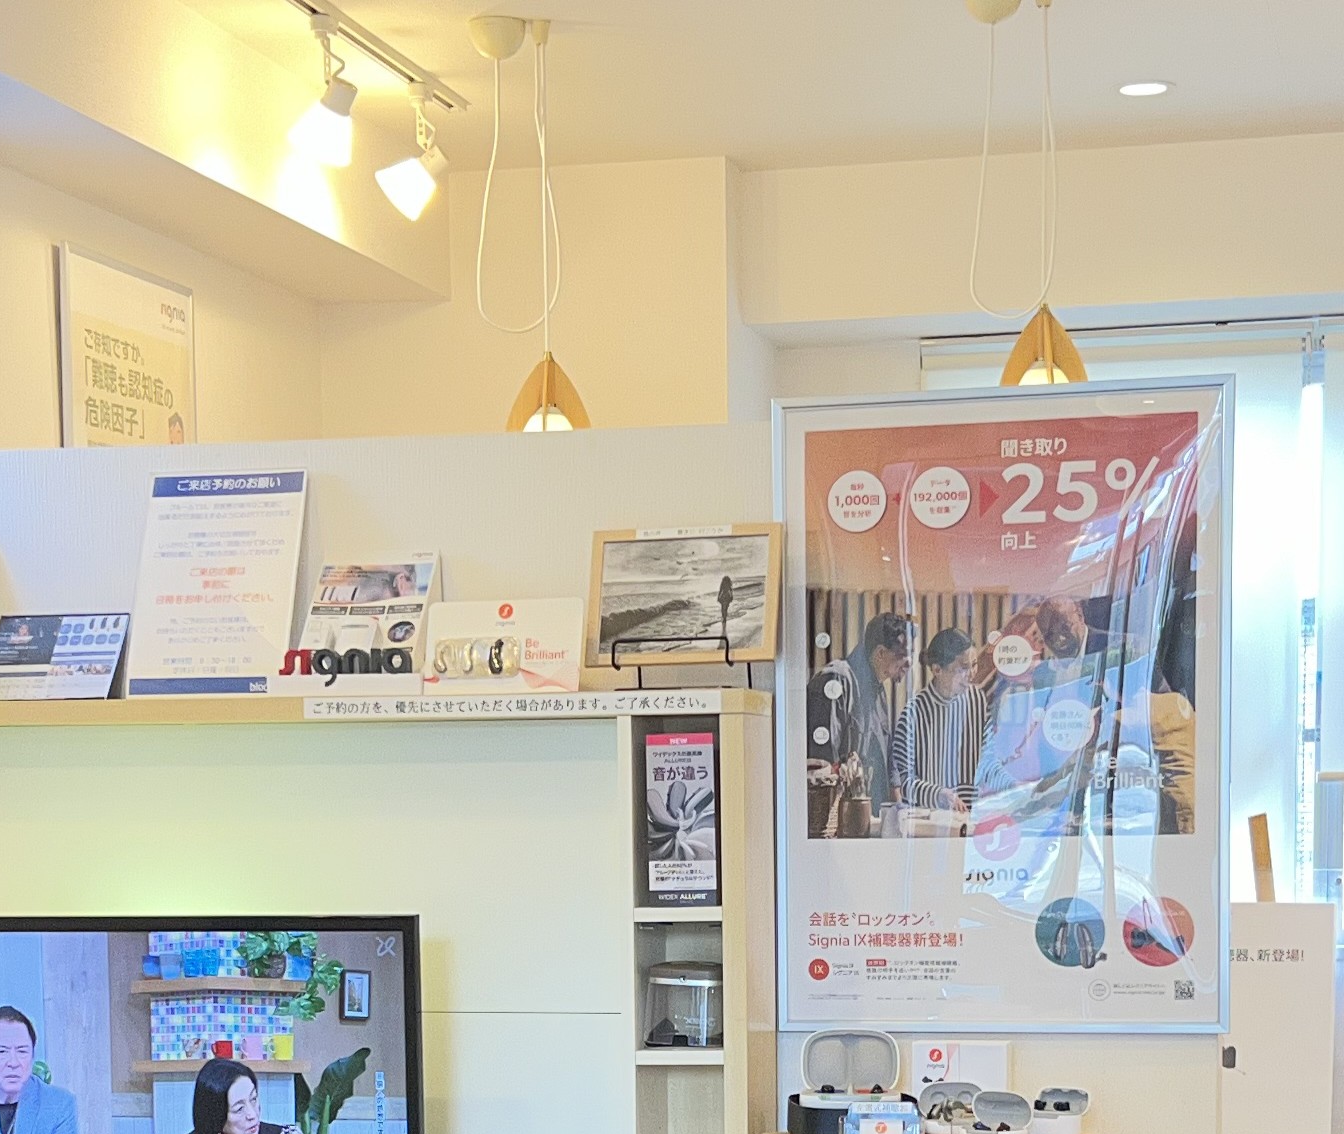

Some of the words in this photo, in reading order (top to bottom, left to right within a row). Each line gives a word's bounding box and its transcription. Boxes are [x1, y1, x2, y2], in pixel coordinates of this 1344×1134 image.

[84, 355, 174, 410] 「難聴も認知症の
[84, 395, 145, 440] 危険因子」
[1000, 437, 1068, 457] 聞き取り
[176, 476, 281, 491] ご来店予約のお願い
[1001, 456, 1160, 526] 25%
[834, 494, 880, 507] 1,000回
[912, 491, 968, 504] 192,000個
[1000, 533, 1038, 551] 向上
[525, 637, 540, 648] Be
[524, 649, 565, 660] Brilliant
[279, 647, 413, 687] signia
[653, 766, 709, 781] 音が違う
[1094, 771, 1165, 790] Brilliant
[965, 867, 1029, 887] signia
[808, 934, 850, 949] Signia
